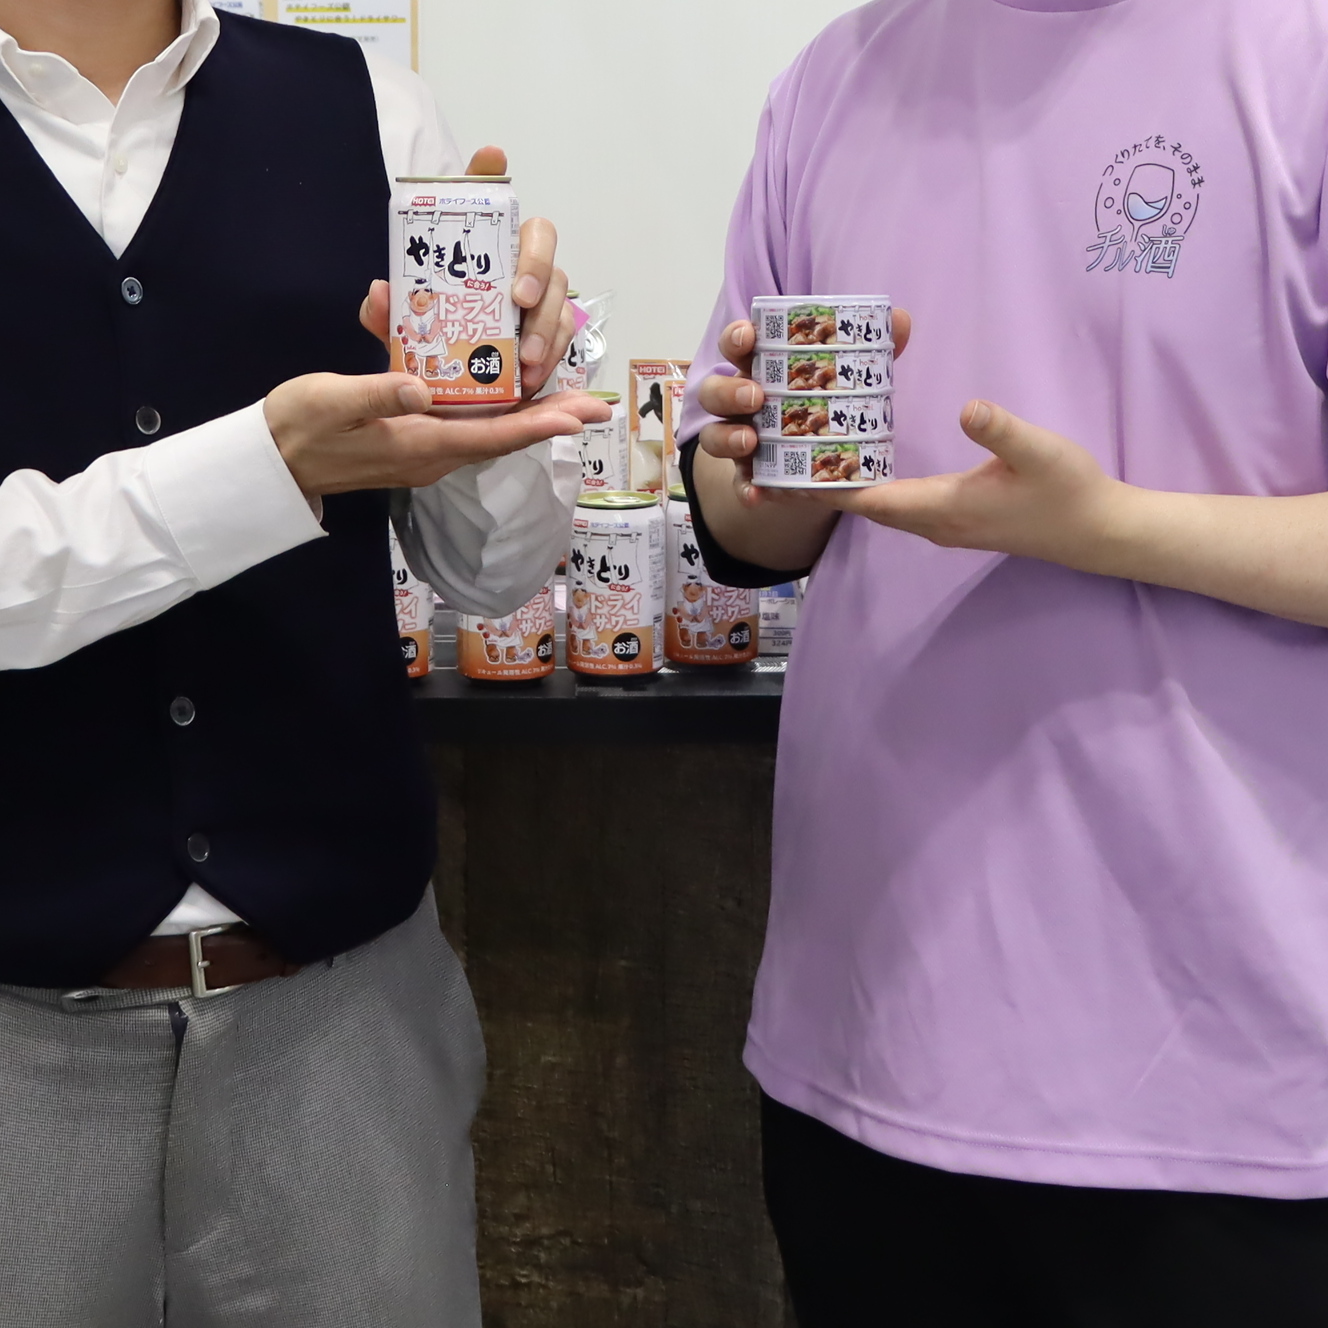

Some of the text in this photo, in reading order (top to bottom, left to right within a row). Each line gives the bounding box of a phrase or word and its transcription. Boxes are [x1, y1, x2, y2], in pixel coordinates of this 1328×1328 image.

[407, 235, 491, 279] やきとり
[438, 293, 504, 321] ドライ
[442, 321, 502, 345] サワー
[838, 319, 882, 342] やきとり
[470, 356, 502, 375] お酒
[838, 364, 882, 387] やきとり
[830, 409, 878, 433] やきとり
[570, 547, 630, 583] やきとり
[589, 593, 642, 614] ドライ
[710, 606, 752, 623] サワー
[592, 615, 640, 633] サワー
[613, 640, 639, 655] お酒
[729, 629, 752, 644] お酒
